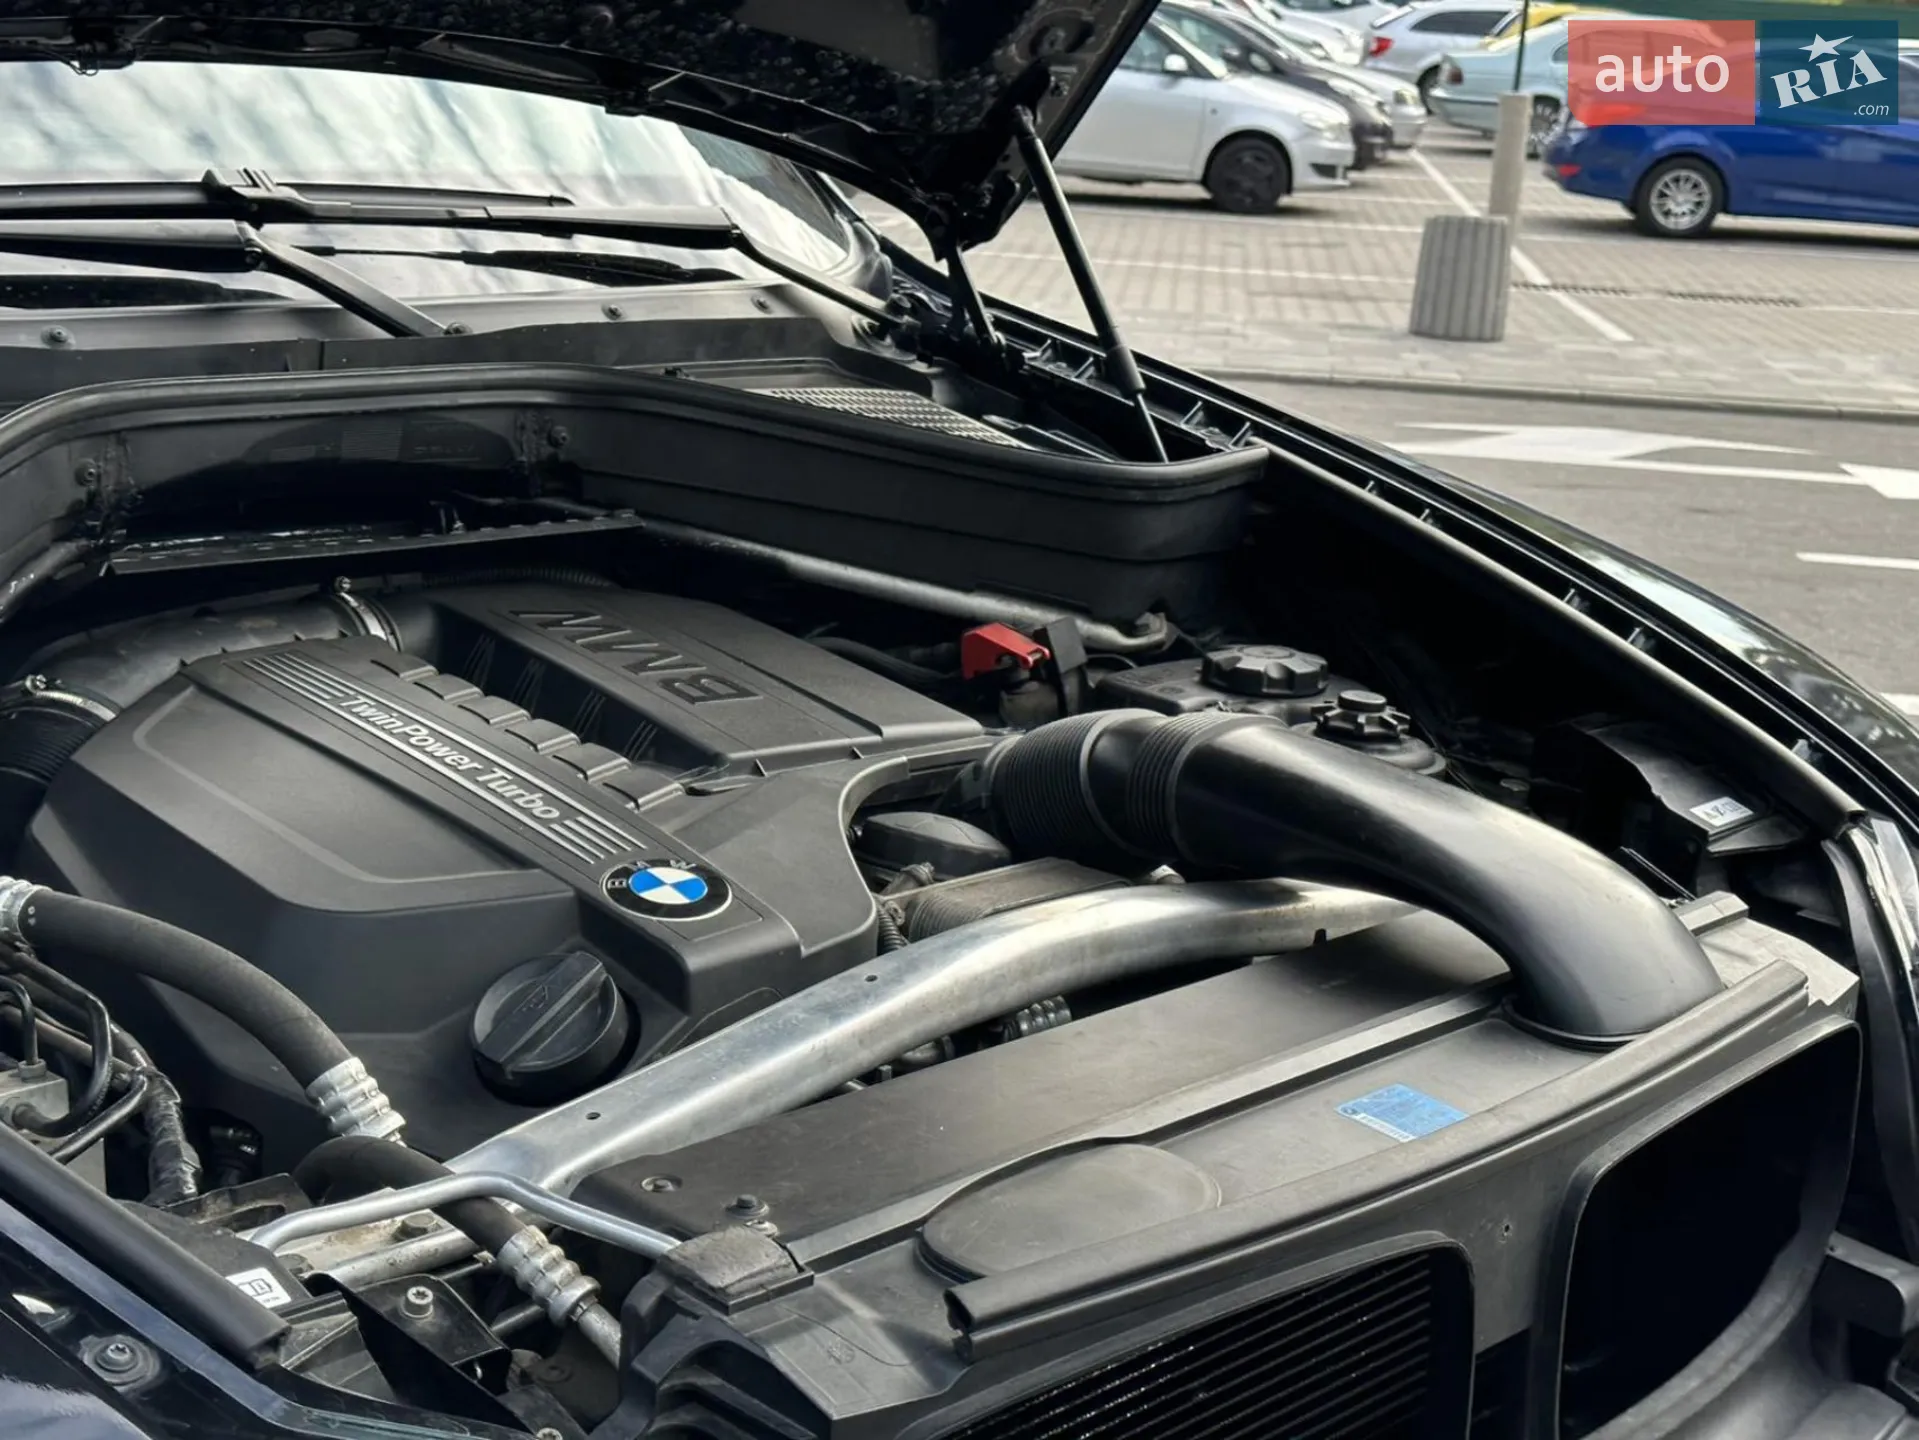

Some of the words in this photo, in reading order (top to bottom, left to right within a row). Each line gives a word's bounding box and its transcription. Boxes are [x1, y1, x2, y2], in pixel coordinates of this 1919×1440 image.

[508, 609, 764, 706] BMW
[340, 696, 484, 771] TwinPower
[475, 767, 561, 820] Turbo
